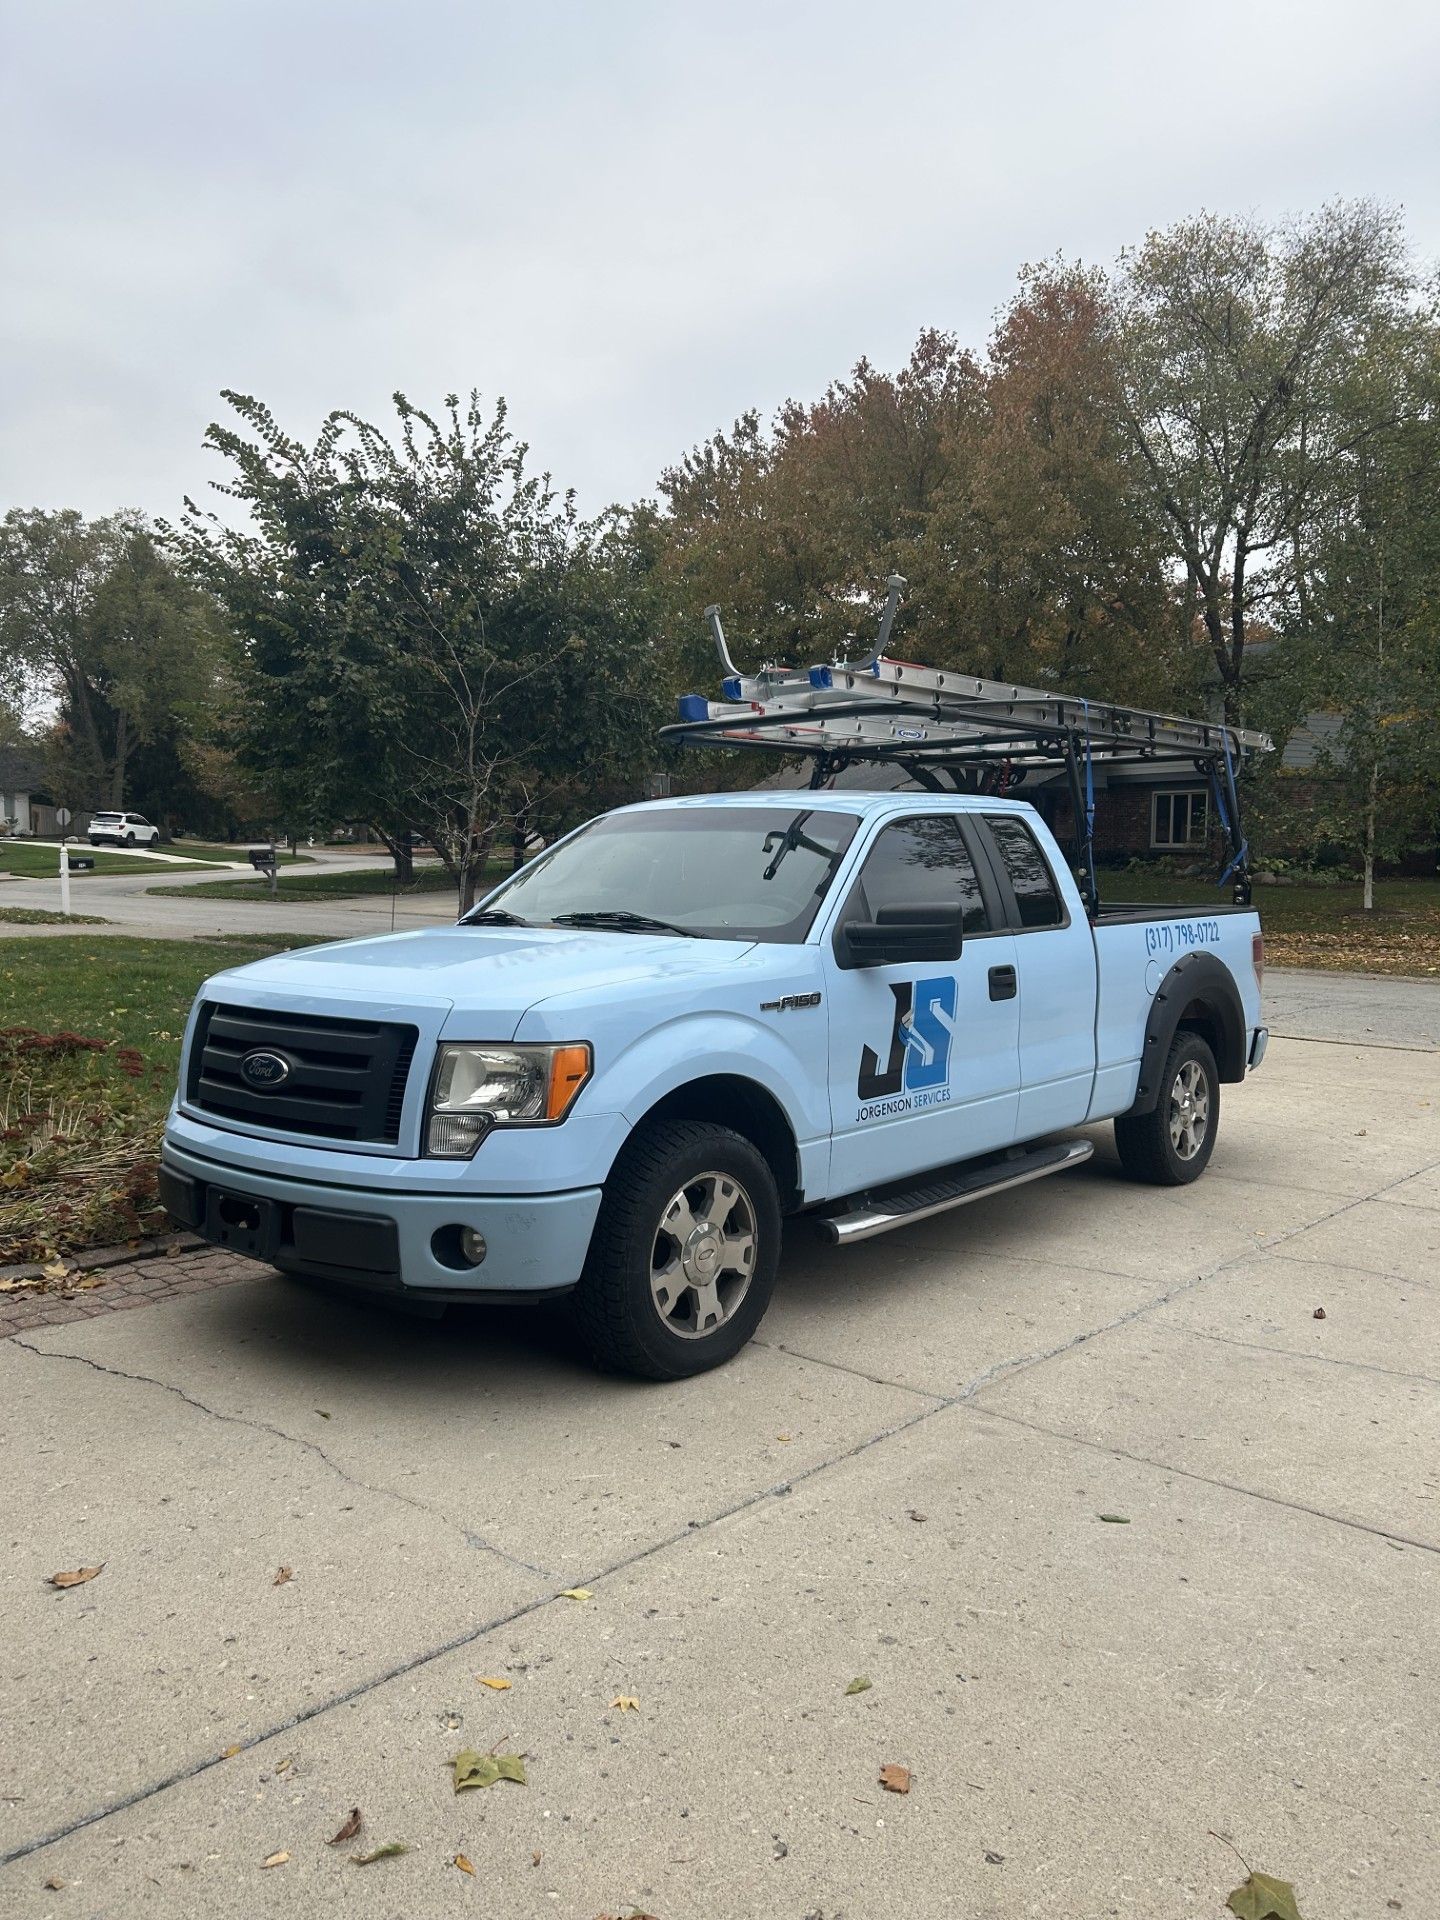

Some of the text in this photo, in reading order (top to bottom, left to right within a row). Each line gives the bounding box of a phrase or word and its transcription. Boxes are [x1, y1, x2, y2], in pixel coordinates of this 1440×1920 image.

[1145, 921, 1220, 956] (317) 798-0722
[855, 1088, 951, 1122] JORGENSON SERVICES
